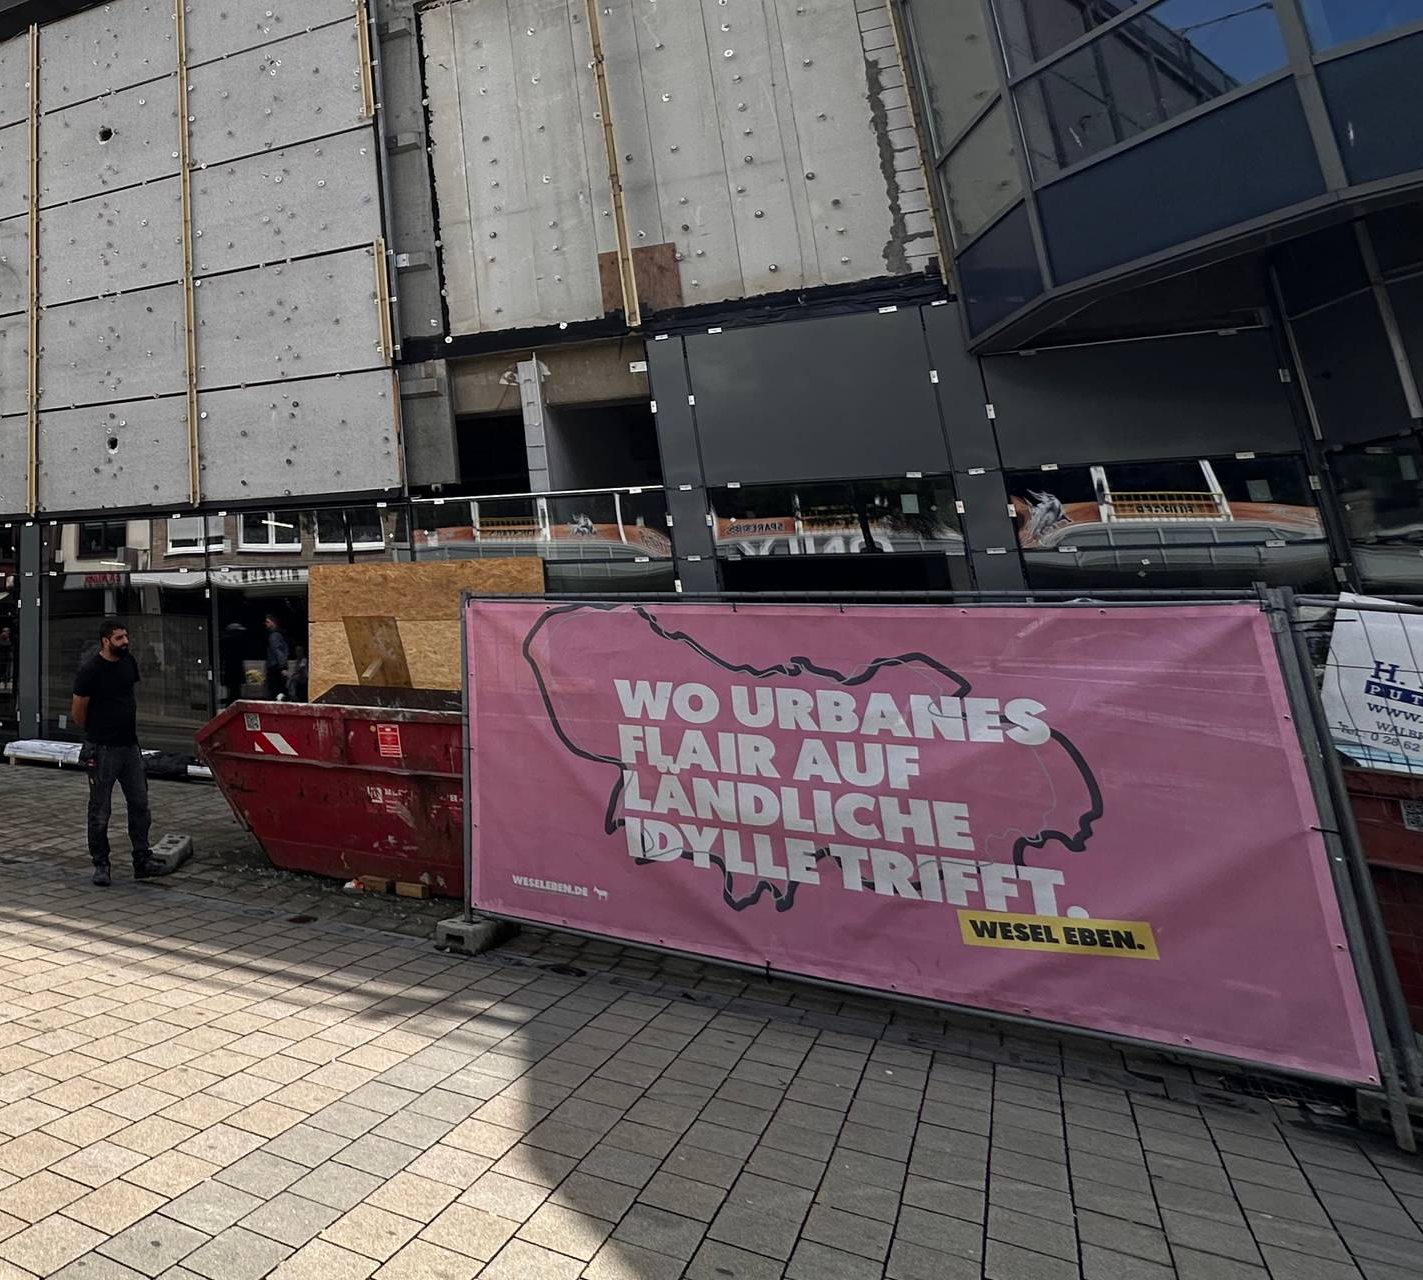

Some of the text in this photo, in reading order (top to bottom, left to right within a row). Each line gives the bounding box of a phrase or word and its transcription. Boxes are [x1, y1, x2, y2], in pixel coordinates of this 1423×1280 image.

[614, 679, 1051, 746] WO URBANES
[618, 724, 920, 790] FLAIR AUF
[623, 757, 975, 851] LÄNDLICHE
[512, 874, 588, 897] WESELEBEN.DE
[625, 816, 1090, 919] IDYLLE TRIFFT.
[969, 919, 1146, 951] WESEL EBEN.
